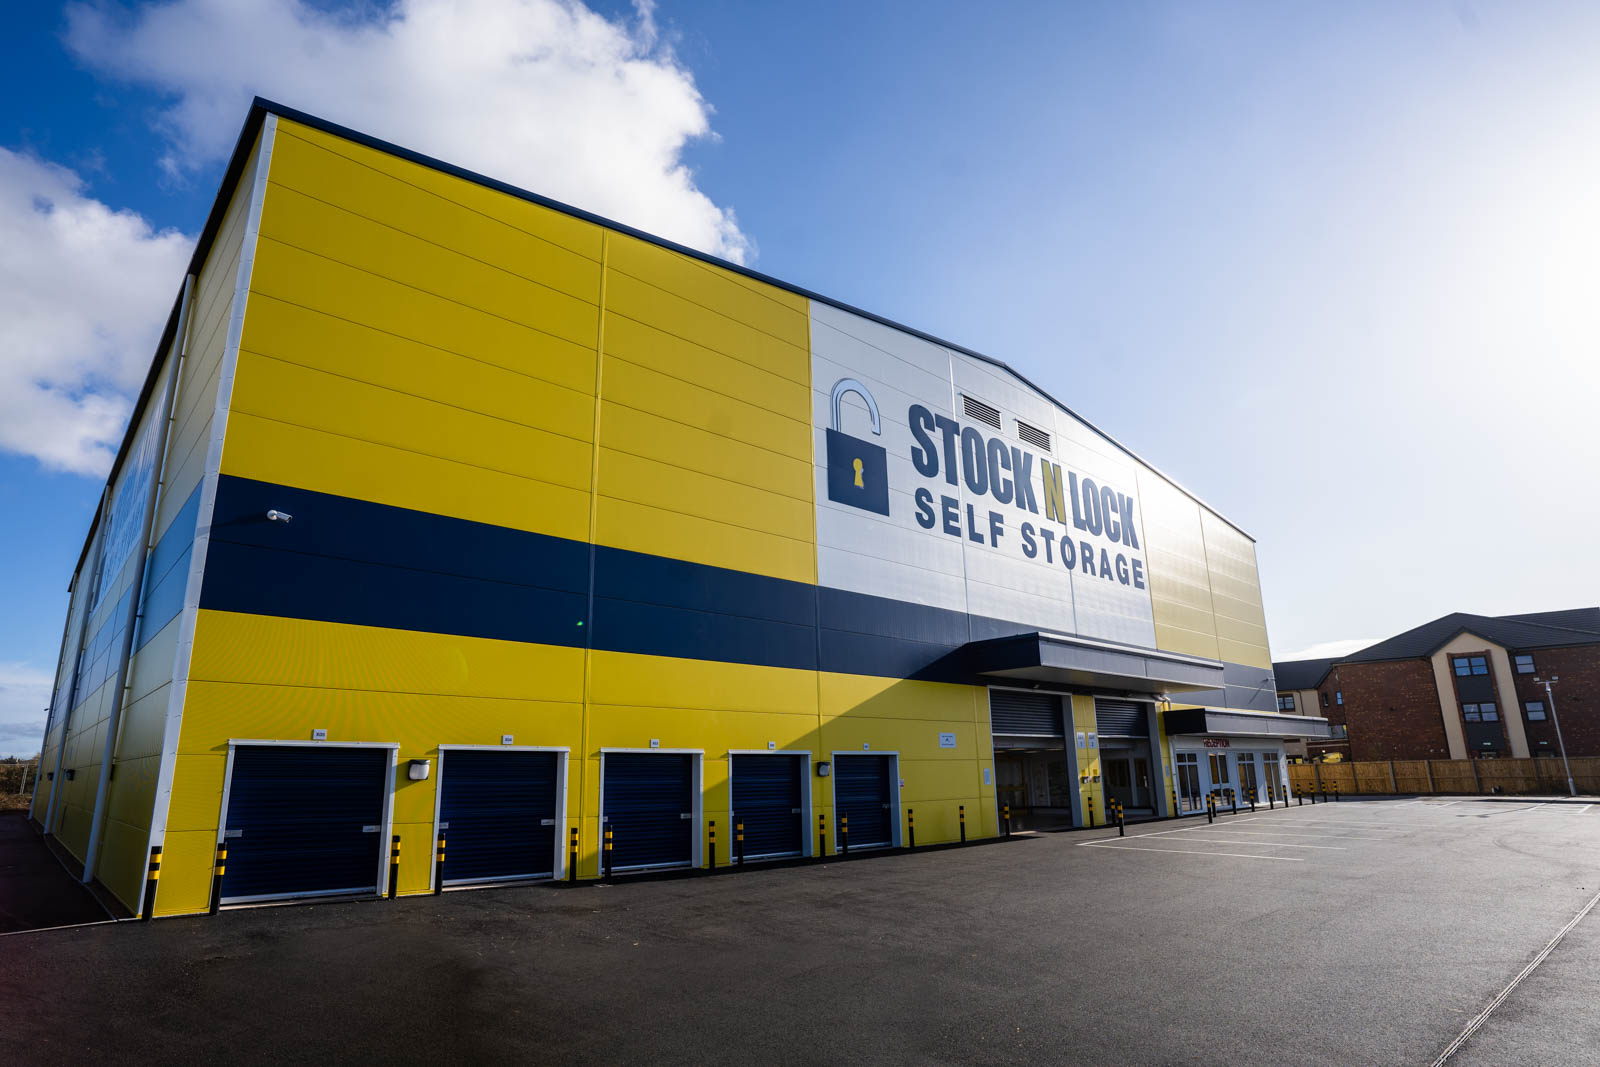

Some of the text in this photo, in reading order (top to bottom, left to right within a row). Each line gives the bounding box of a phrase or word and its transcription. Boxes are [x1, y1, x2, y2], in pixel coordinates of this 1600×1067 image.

[909, 404, 1140, 551] STOCK N LOCK
[915, 487, 1145, 590] SELF STORAGE
[1203, 737, 1231, 748] RECEPTION
